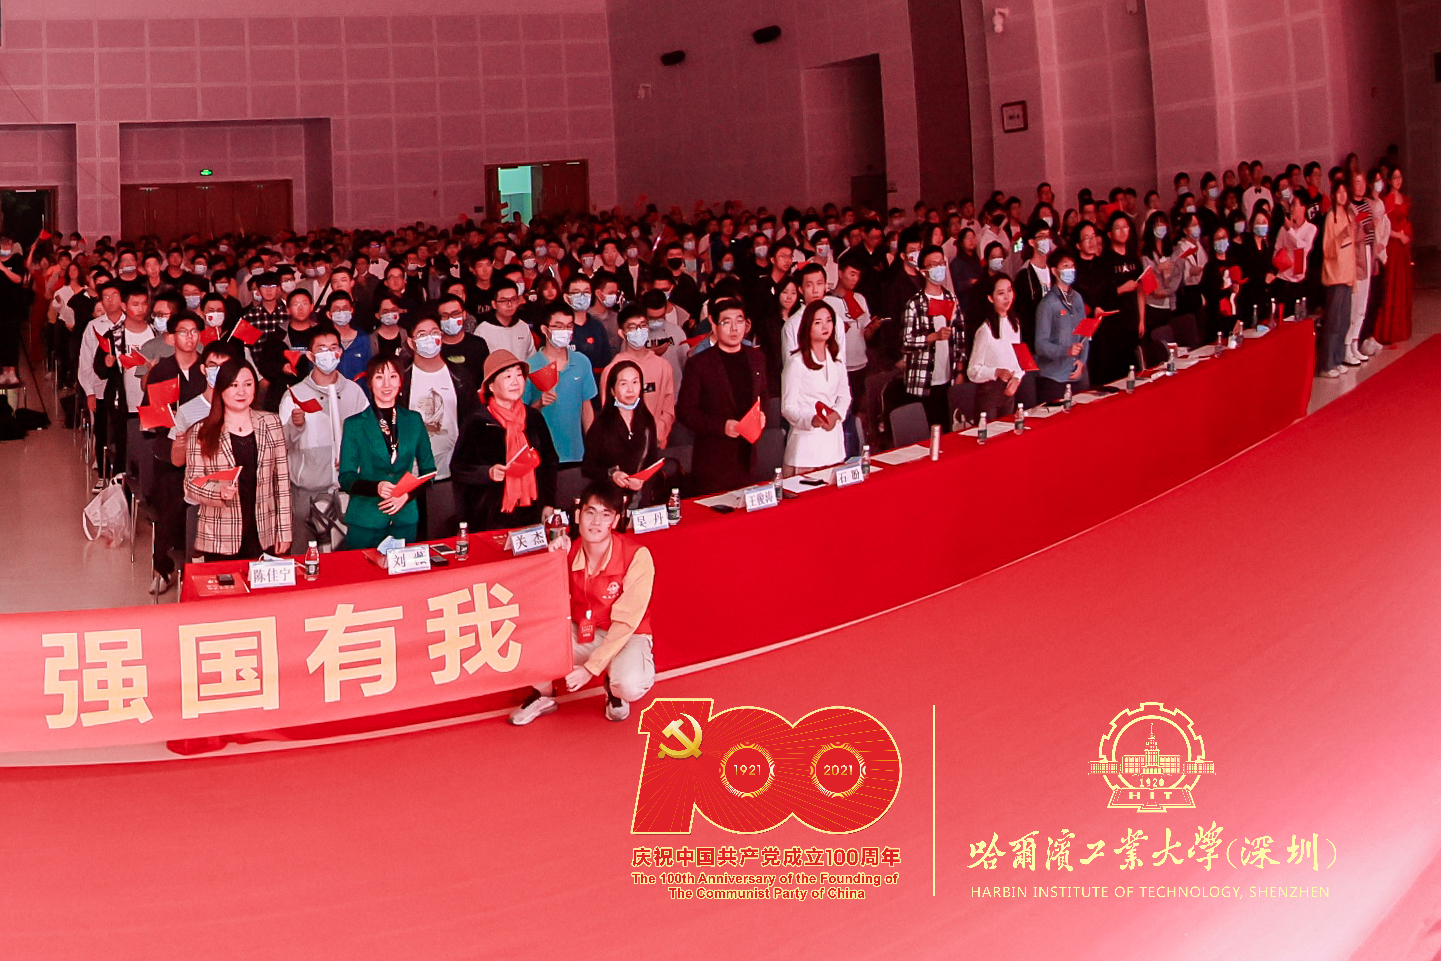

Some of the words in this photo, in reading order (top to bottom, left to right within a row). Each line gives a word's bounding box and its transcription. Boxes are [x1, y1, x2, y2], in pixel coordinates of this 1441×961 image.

[516, 531, 545, 550] 关杰
[252, 567, 291, 584] 陈佳宁
[43, 581, 521, 729] 强国有我
